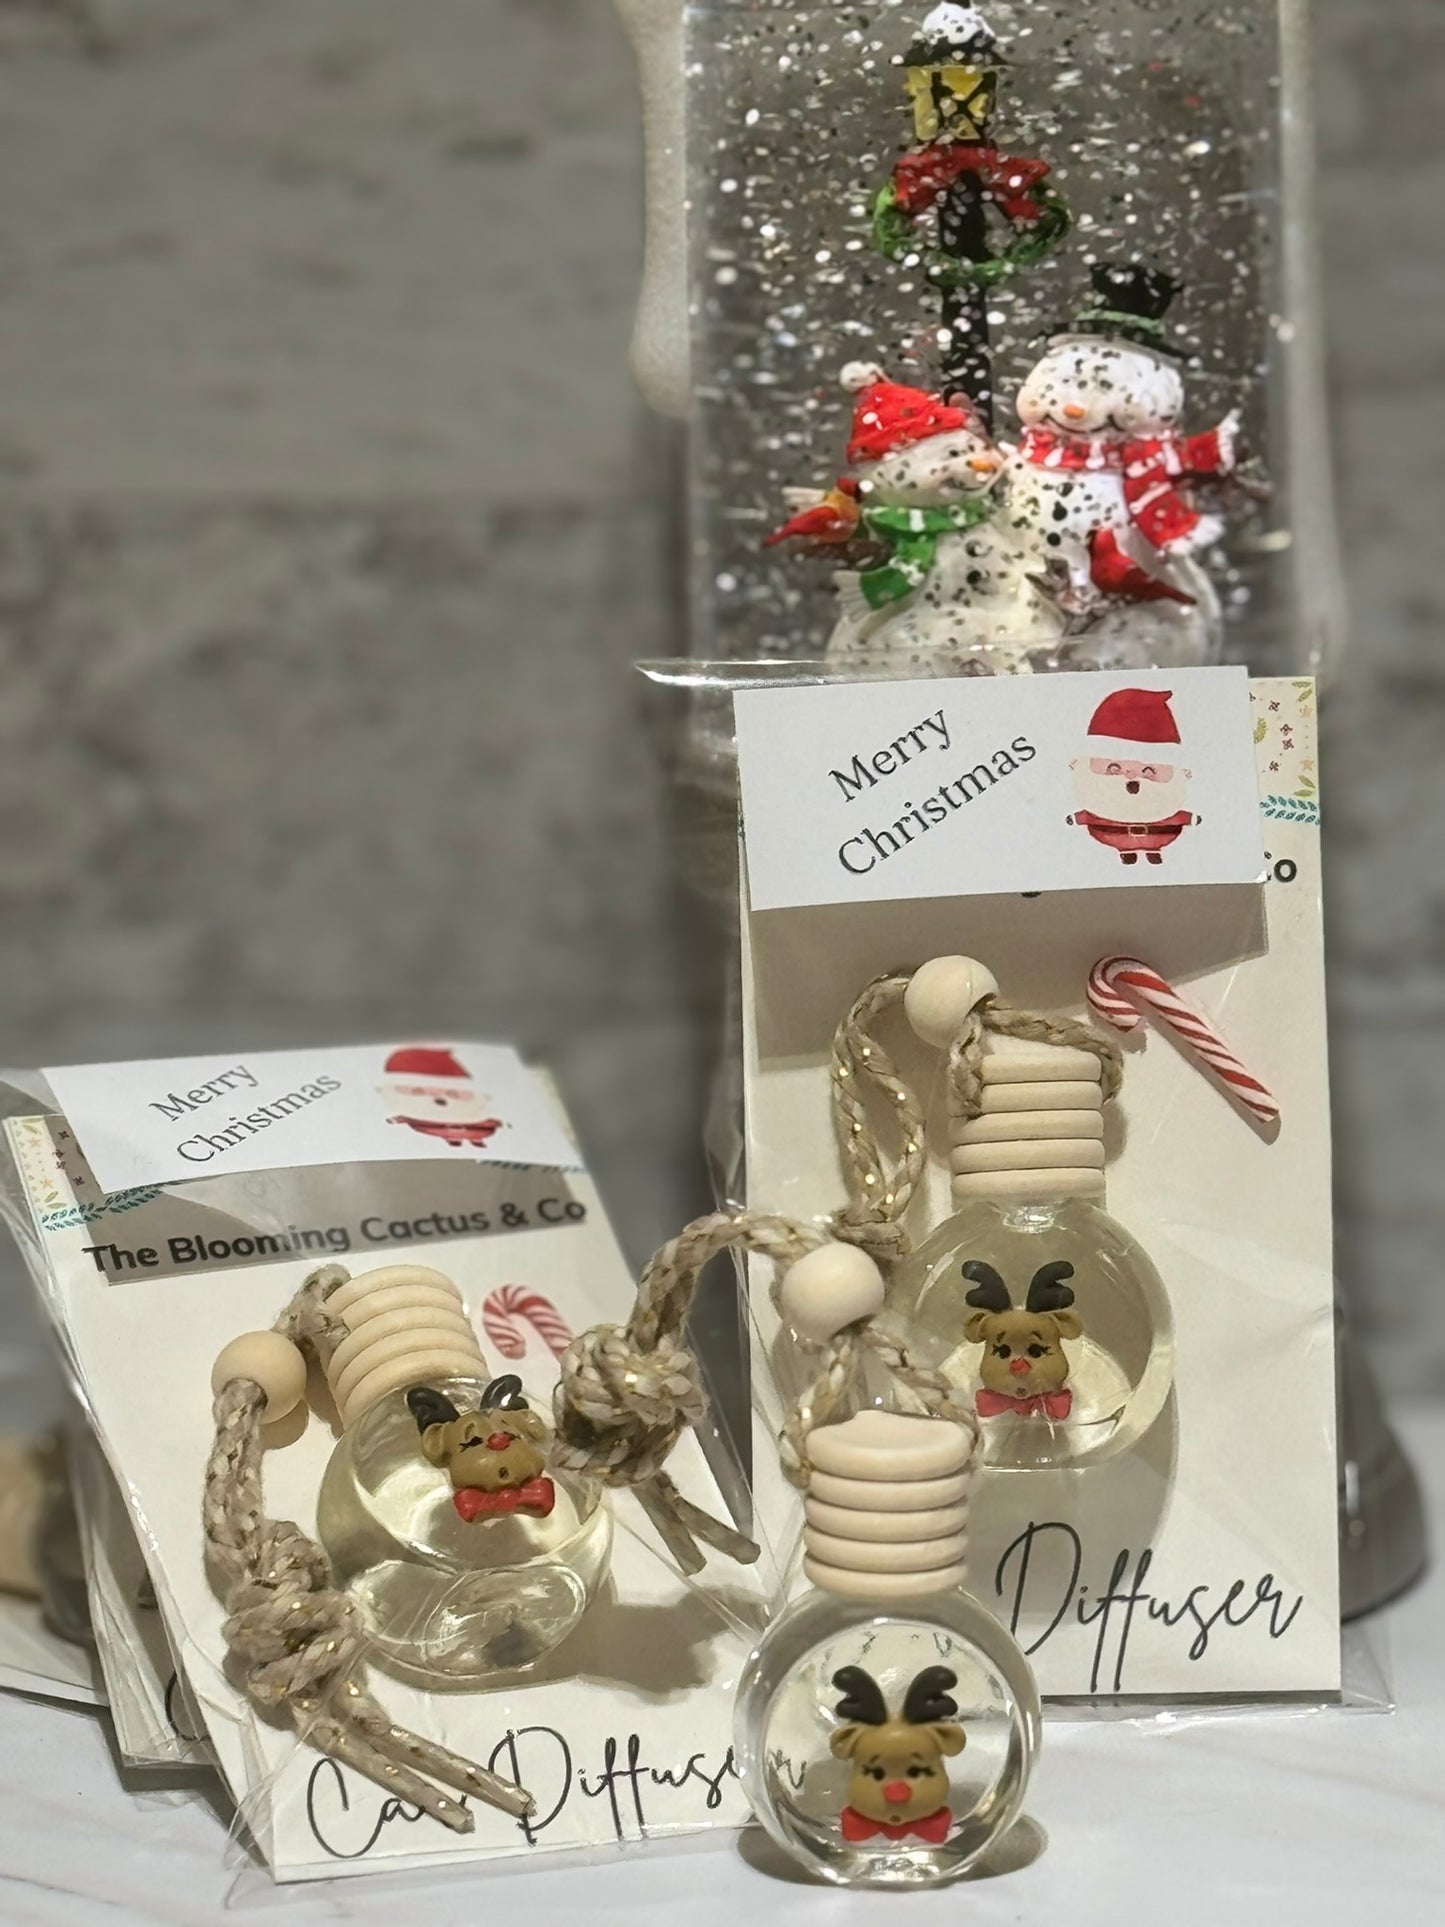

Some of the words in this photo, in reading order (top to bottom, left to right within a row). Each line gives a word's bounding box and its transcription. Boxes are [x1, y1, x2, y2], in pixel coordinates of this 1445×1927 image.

[828, 709, 956, 803] Merry
[837, 733, 1038, 877] Christmas
[148, 1063, 260, 1123] Merry
[176, 1073, 342, 1166] Christmas
[82, 1244, 161, 1274] The
[170, 1219, 352, 1264] Blooming
[359, 1208, 491, 1241] Cactus
[499, 1201, 528, 1228] &
[535, 1196, 588, 1224] Co
[996, 1521, 1304, 1693] Diffuser
